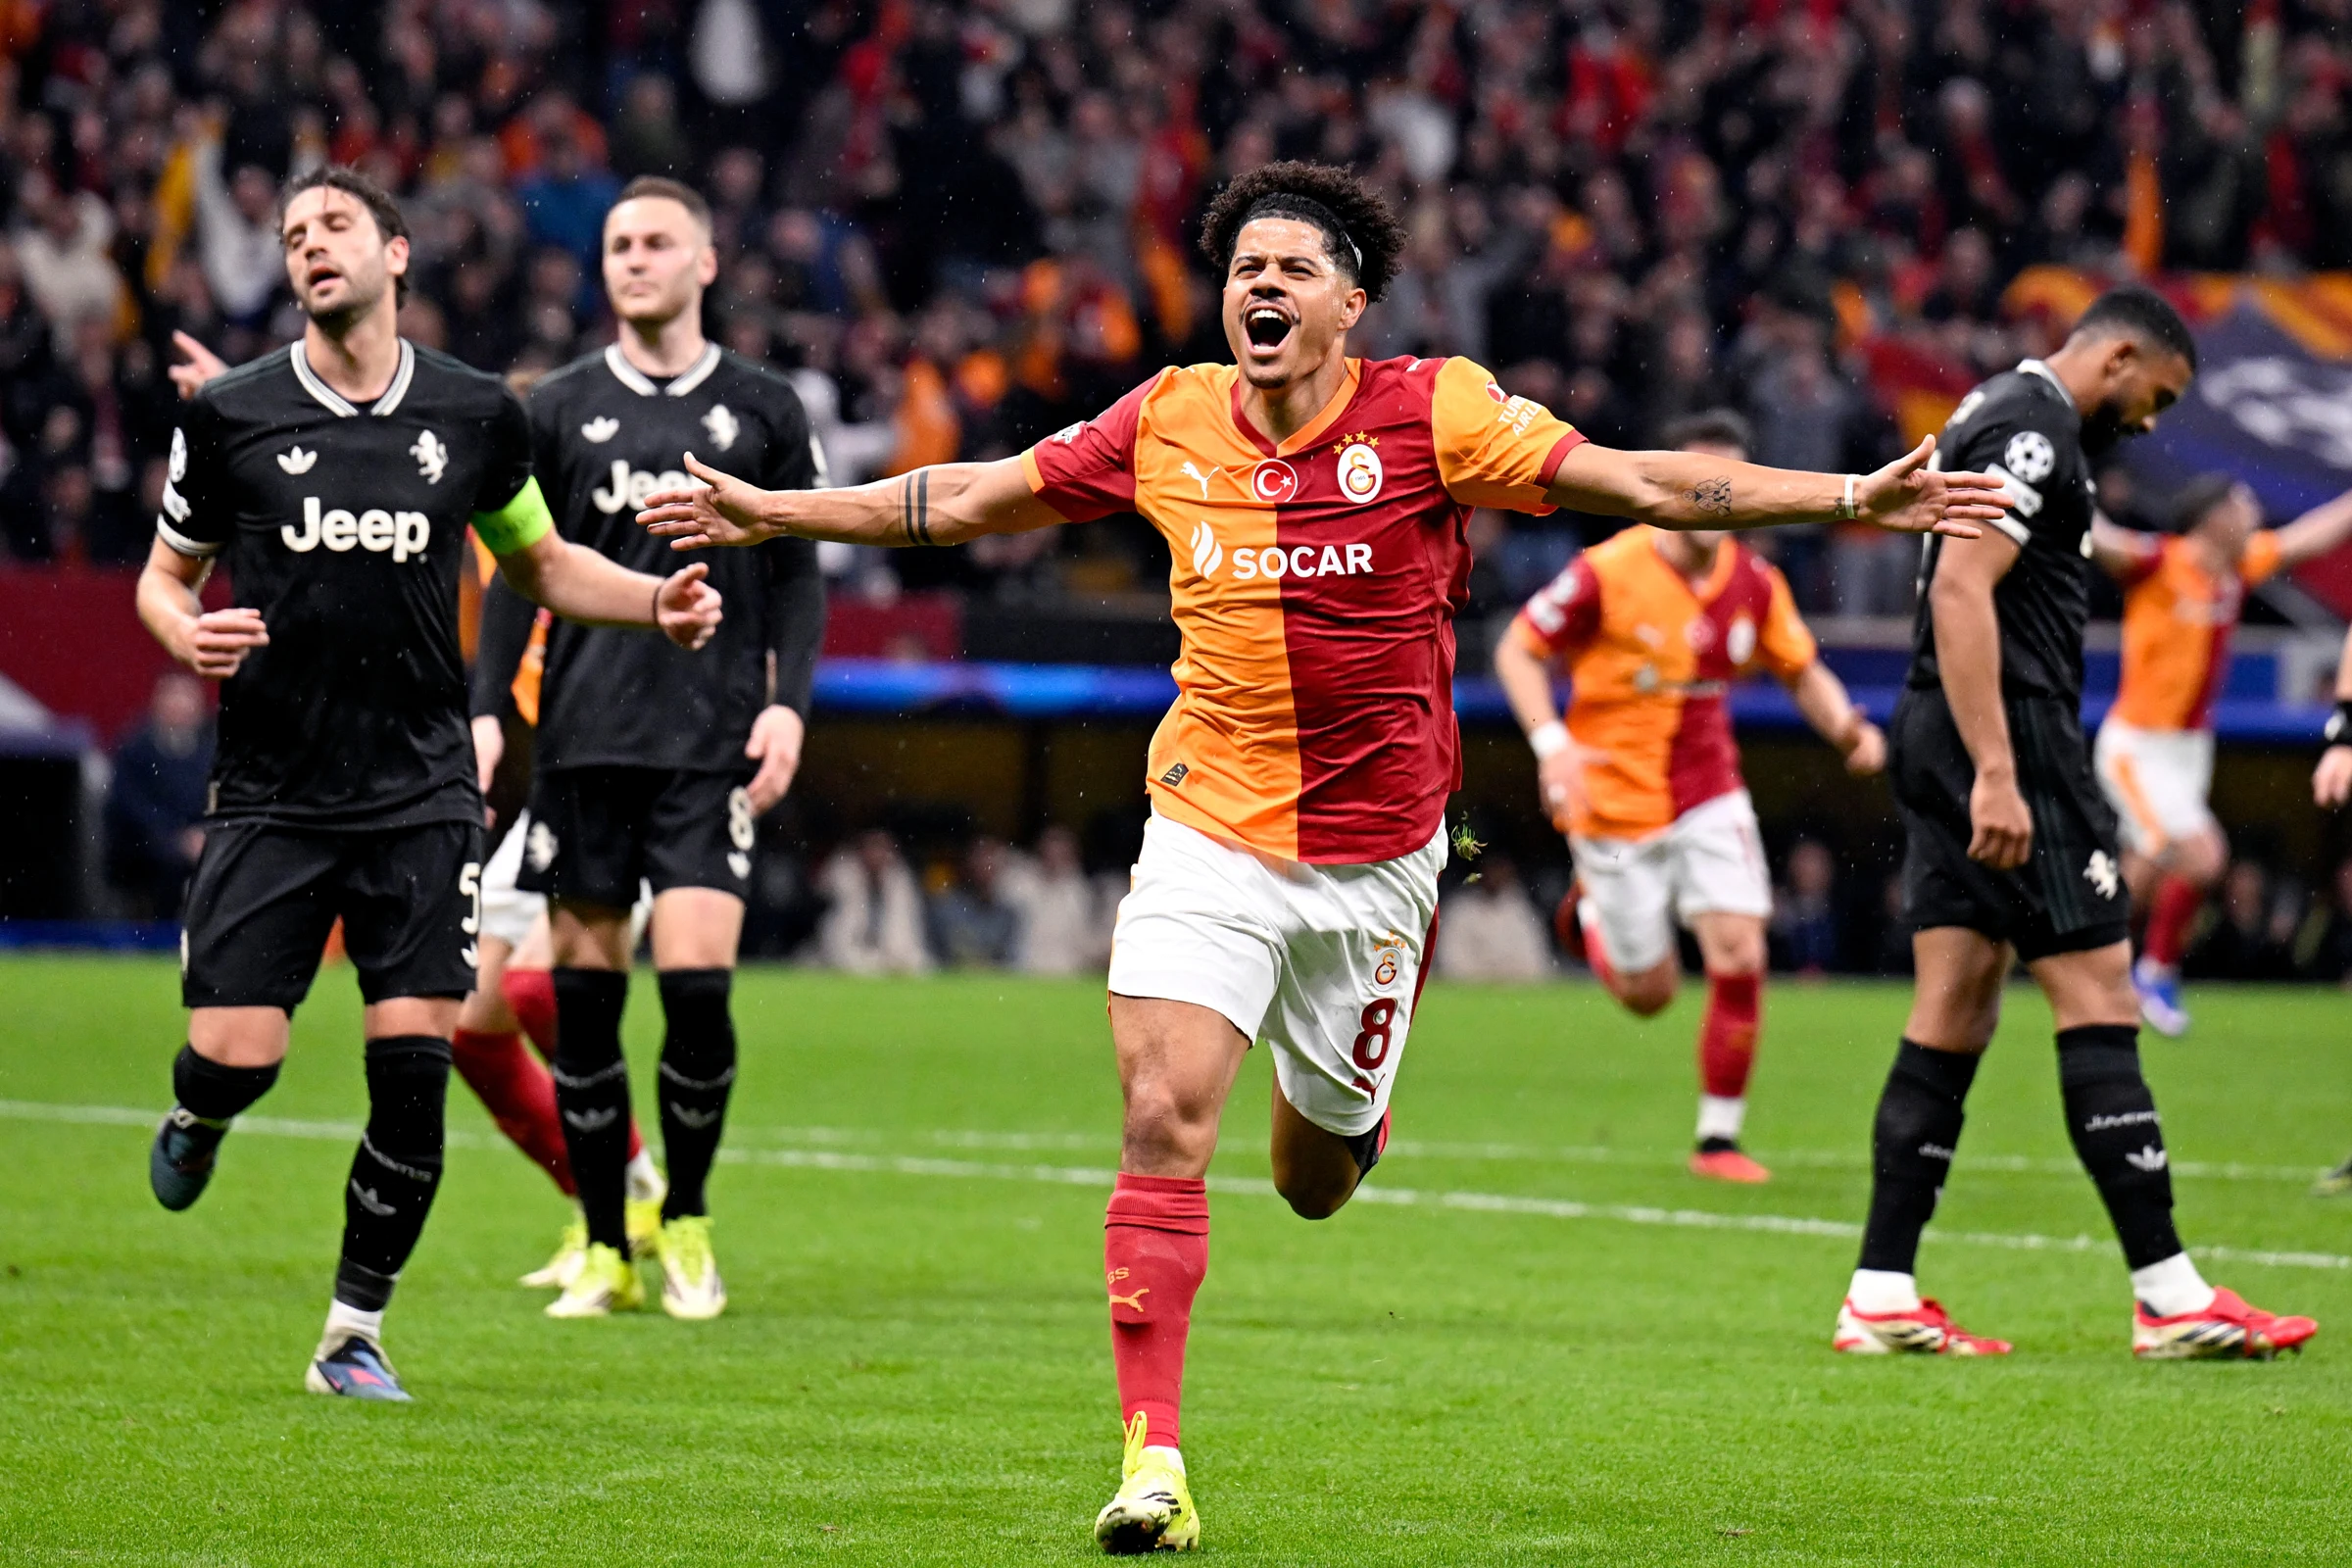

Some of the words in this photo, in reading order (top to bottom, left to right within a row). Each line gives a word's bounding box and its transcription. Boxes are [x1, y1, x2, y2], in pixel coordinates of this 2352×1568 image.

[280, 496, 430, 564] Jeep
[1232, 543, 1374, 580] SOCAR
[728, 785, 755, 852] 8
[459, 861, 480, 935] 5
[1351, 997, 1398, 1071] 8
[1107, 1266, 1130, 1285] GS
